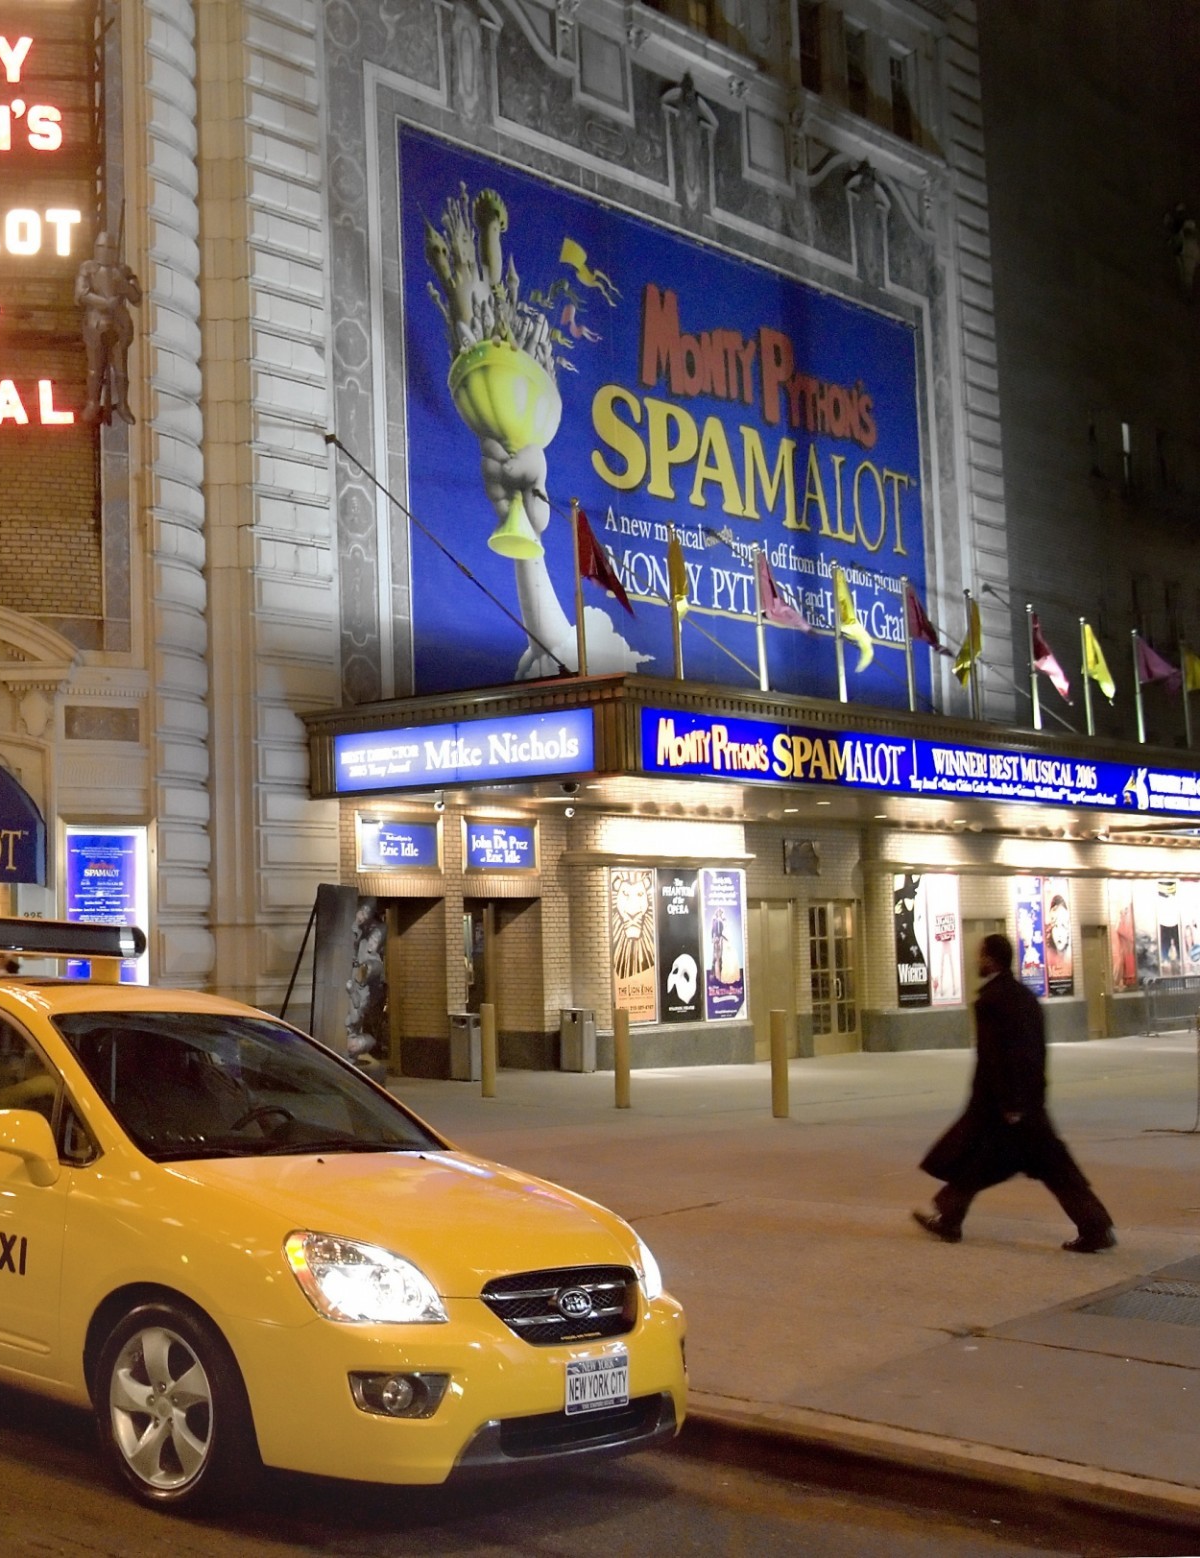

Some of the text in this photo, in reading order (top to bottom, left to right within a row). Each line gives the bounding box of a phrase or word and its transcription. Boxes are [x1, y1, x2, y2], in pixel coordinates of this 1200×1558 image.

[640, 283, 878, 449] MONTY PYTHON'S
[590, 383, 908, 556] SPAMALOT
[604, 505, 618, 532] A
[620, 515, 652, 540] new
[731, 537, 769, 569] rippd
[770, 543, 788, 569] off
[789, 545, 815, 575] from
[604, 544, 703, 606] MONY
[805, 587, 825, 609] and
[871, 601, 906, 643] Grai
[423, 727, 580, 771] Mike Nichols
[656, 717, 905, 786] MONTY PYTHON'S SPAMALOT
[931, 747, 988, 778] WINNER!
[989, 754, 1021, 782] BEST
[1020, 756, 1075, 788] MUSICAL
[379, 841, 420, 857] Eric Idle
[471, 834, 493, 852] John
[509, 836, 529, 850] Prez
[486, 850, 521, 864] Eric Idle
[667, 903, 690, 916] OPERA
[568, 1370, 628, 1402] NEW YORK CITY
